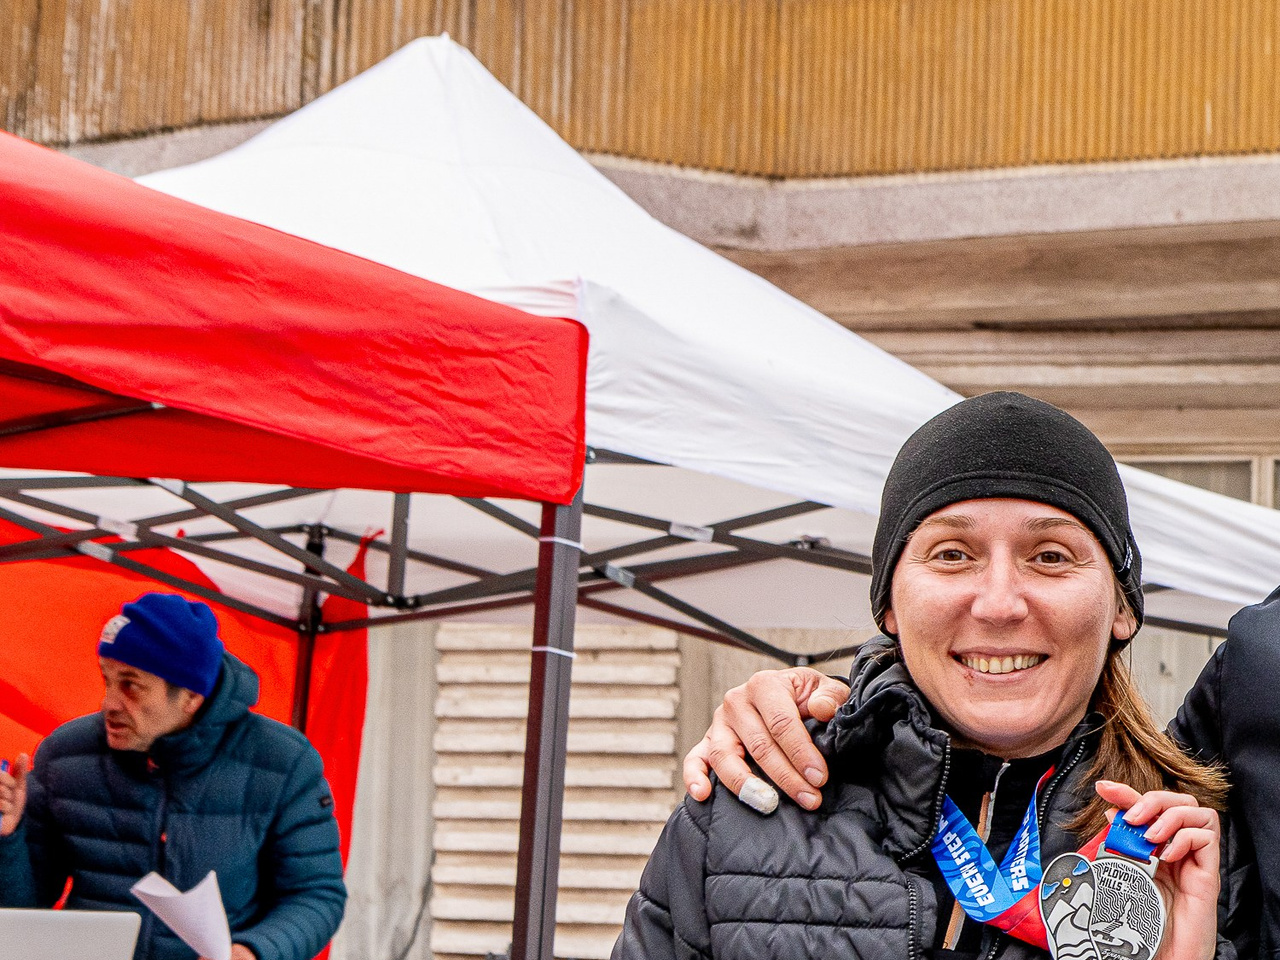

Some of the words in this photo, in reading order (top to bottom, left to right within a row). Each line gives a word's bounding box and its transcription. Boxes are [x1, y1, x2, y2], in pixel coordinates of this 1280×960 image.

[943, 831, 971, 866] STEP
[1102, 866, 1138, 884] PLOVDIV
[1100, 877, 1123, 892] HILLS
